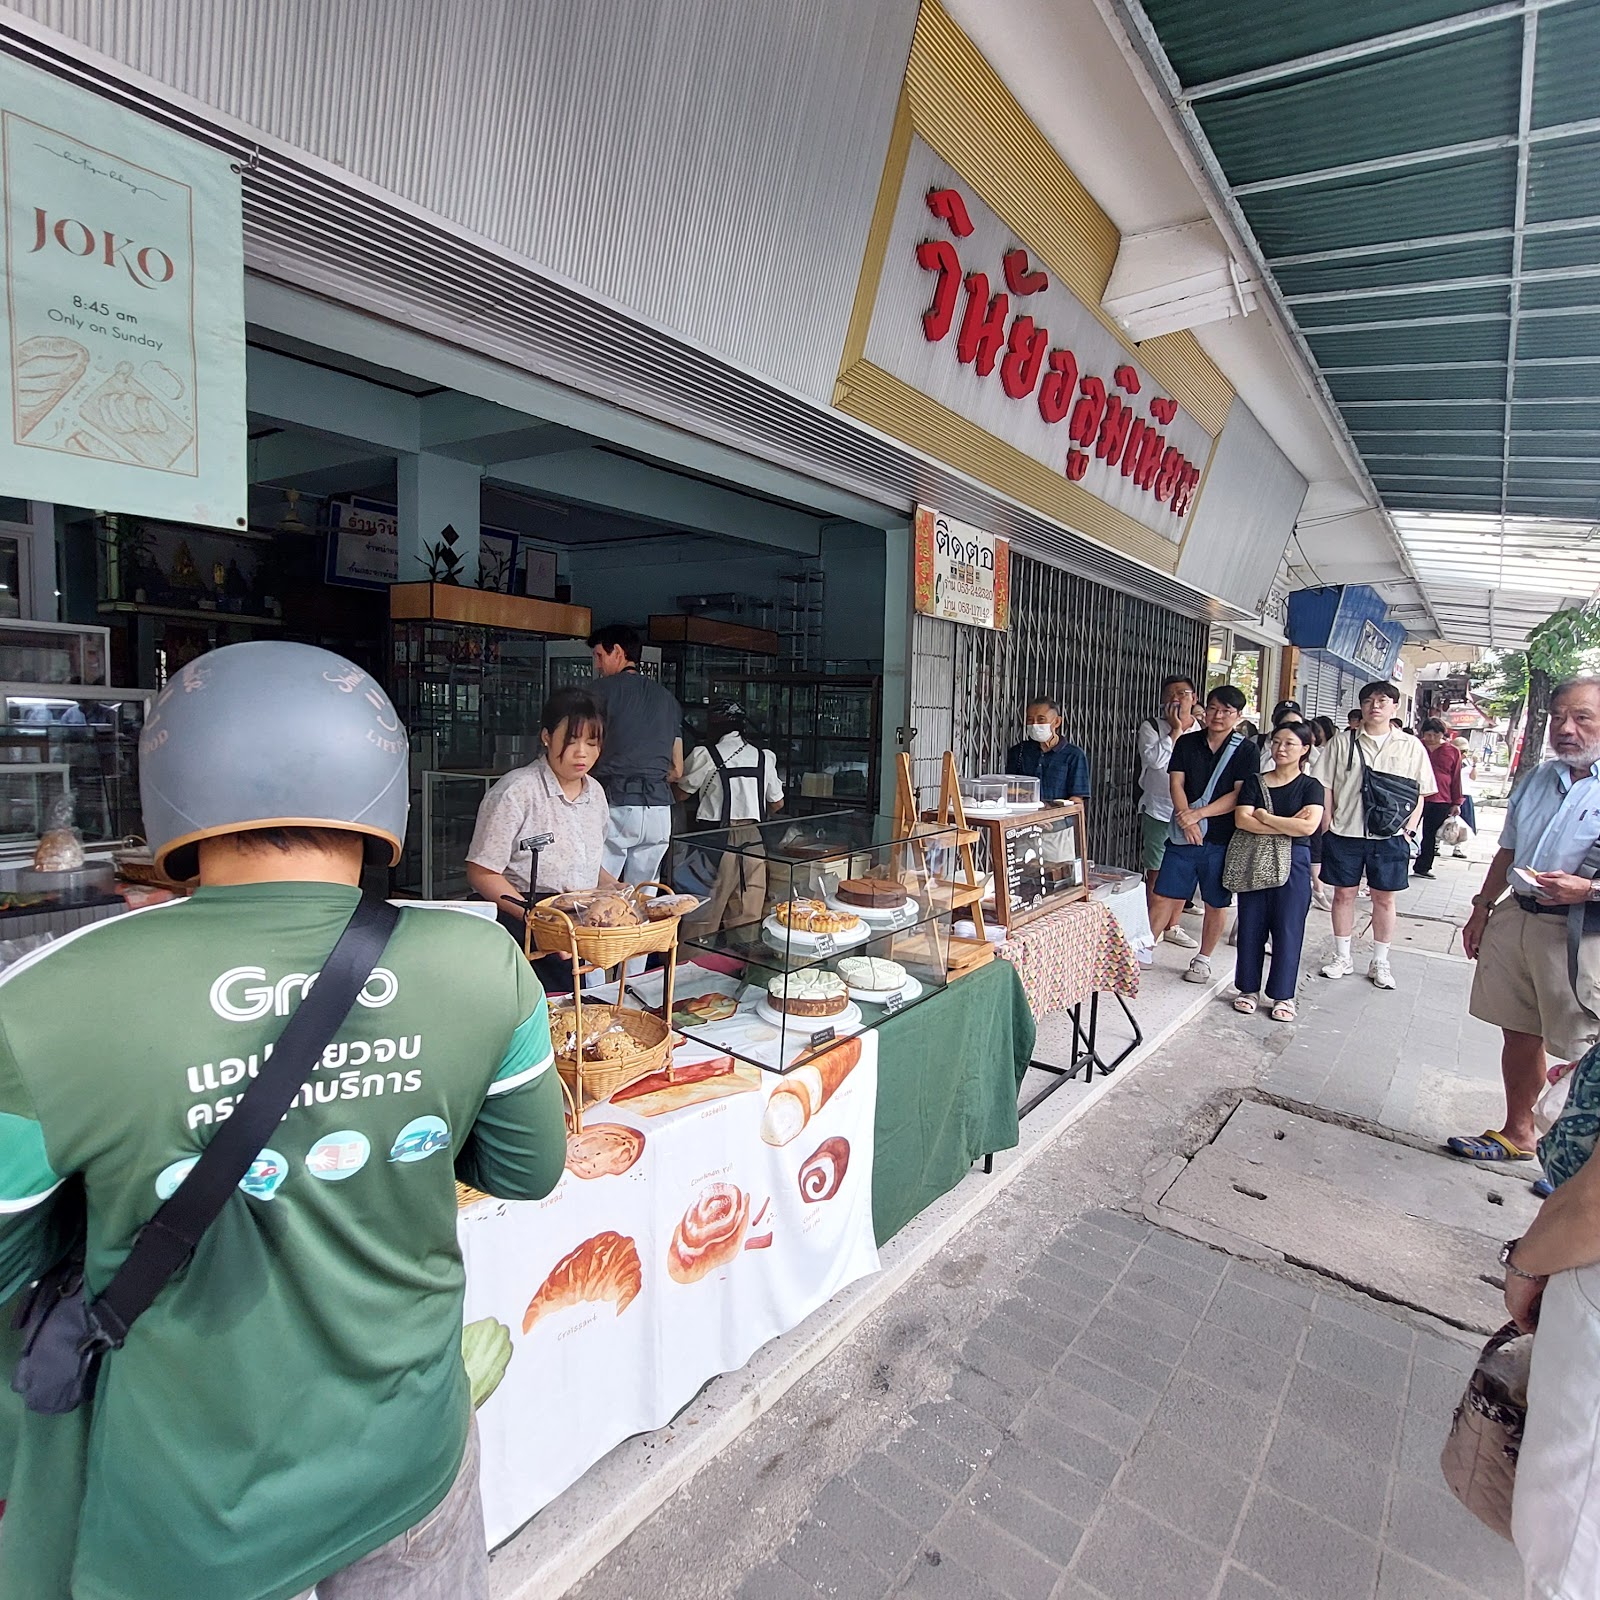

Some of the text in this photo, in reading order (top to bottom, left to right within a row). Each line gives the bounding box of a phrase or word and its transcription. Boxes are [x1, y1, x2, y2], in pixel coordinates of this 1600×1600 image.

[28, 206, 174, 290] JOKO
[47, 309, 163, 351] Only on Sunday
[73, 295, 138, 324] 8:45 am
[936, 519, 994, 571] ติดต่อ
[540, 1193, 563, 1208] bread
